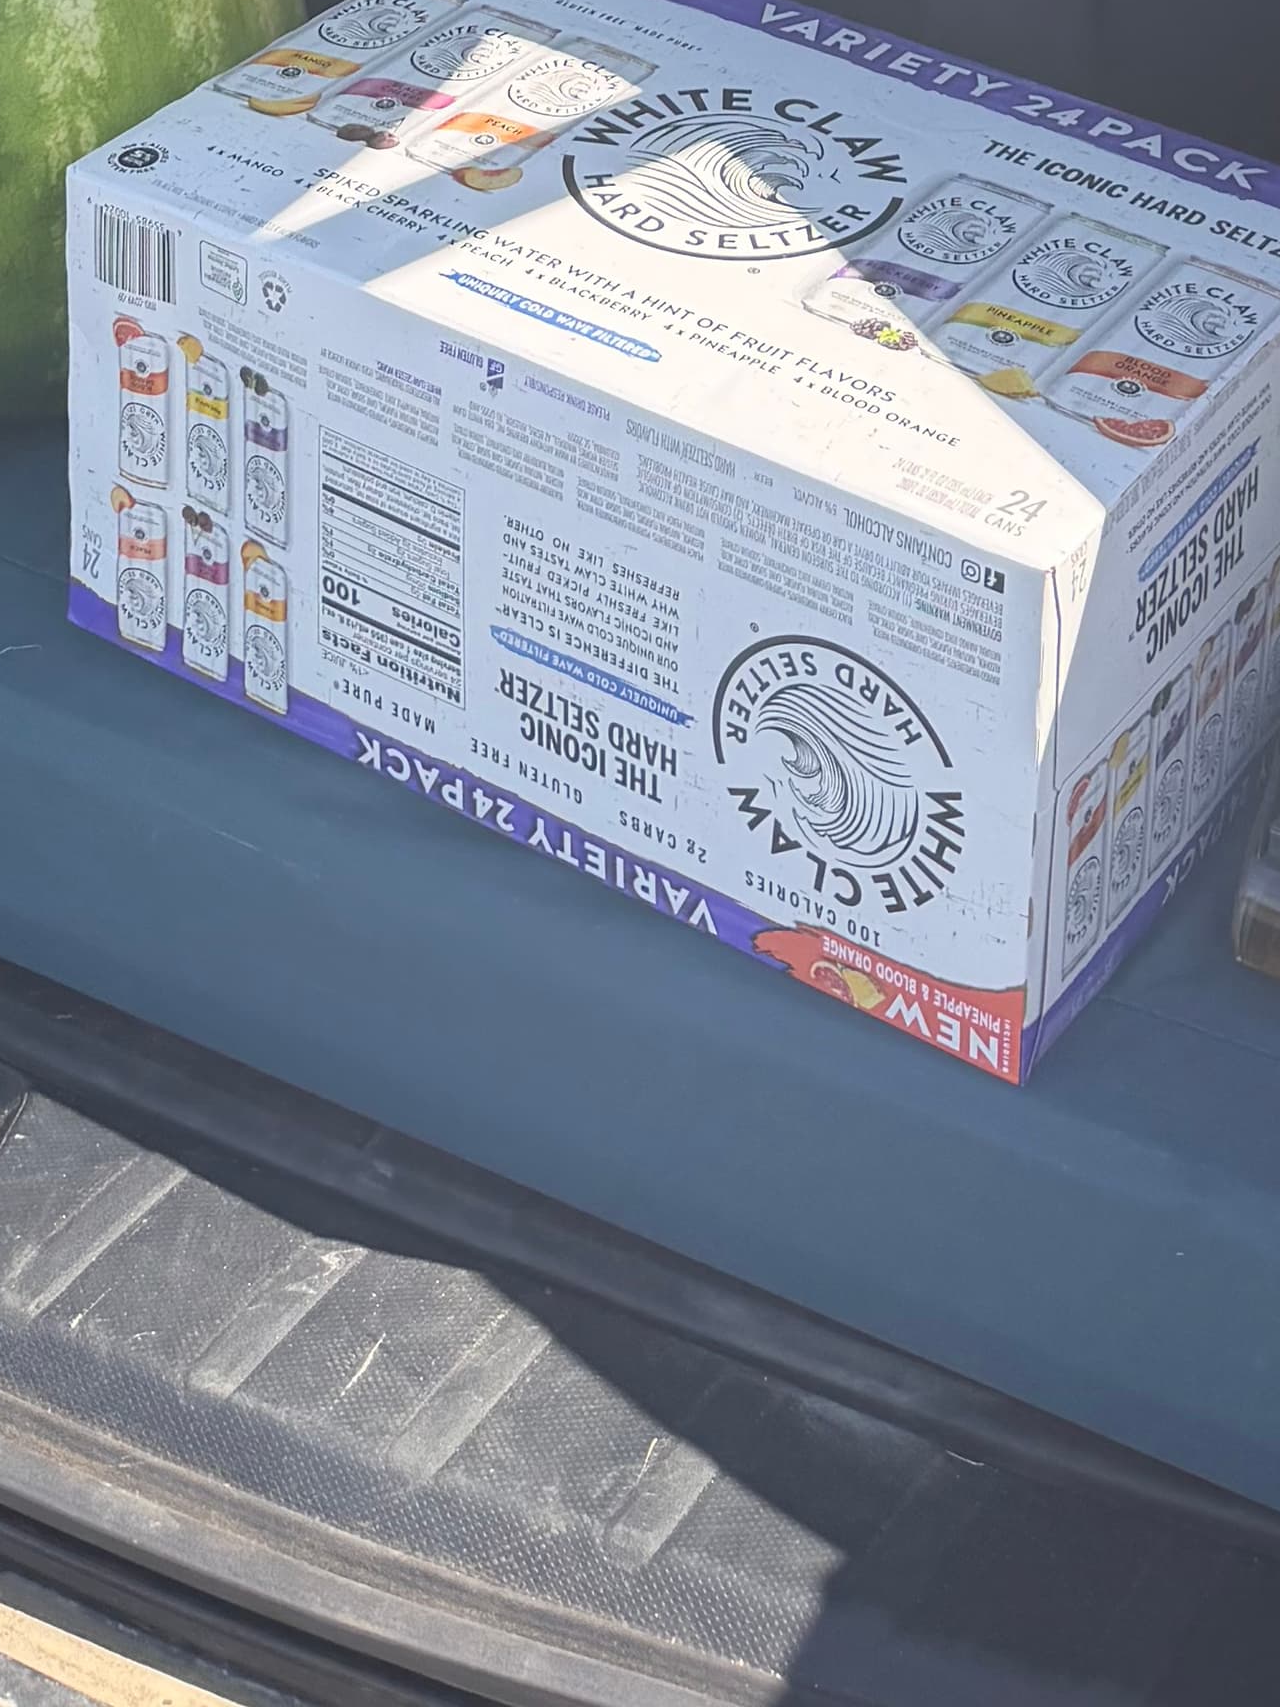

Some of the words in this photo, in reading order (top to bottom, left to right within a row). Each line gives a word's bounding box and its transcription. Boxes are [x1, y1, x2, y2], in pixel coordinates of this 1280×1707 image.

[761, 3, 1011, 97] VARIETY
[1015, 94, 1080, 128] 24
[1088, 117, 1269, 190] PACK
[573, 87, 753, 146] WHITE
[774, 97, 907, 184] CLAW
[227, 152, 285, 178] MANGO
[982, 139, 1034, 167] THE
[1034, 157, 1129, 199] ICONIC
[1129, 192, 1207, 228] HARD
[583, 172, 666, 234] HARD
[684, 203, 871, 251] SELTZER
[314, 166, 381, 198] SPIKED
[382, 193, 489, 241] SPARKLING
[494, 235, 564, 269] WATER
[567, 263, 626, 295] WITH
[621, 288, 638, 300] A
[642, 294, 695, 322] HINT
[696, 314, 726, 332] OF
[727, 329, 793, 361] FRUIT
[796, 356, 897, 403] FLAVORS
[549, 275, 653, 322] BLACKBERRY
[986, 305, 1054, 338] PINEAPPLE
[687, 331, 782, 376] PINEAPPLE
[819, 385, 881, 414] BLOOD
[885, 411, 961, 448] ORANGE
[997, 489, 1048, 524] 24
[501, 514, 545, 541] OTHER.
[501, 566, 533, 591] TASTE
[529, 546, 570, 572] TASTES
[321, 576, 361, 606] 100
[547, 568, 590, 598] PICKED
[611, 560, 680, 600] REFRESHES
[501, 585, 557, 620] FILTRATION
[558, 608, 585, 631] WAVE
[564, 595, 611, 627] FLAVORS
[595, 590, 647, 623] FRESHLY
[321, 630, 371, 664] Facts
[391, 606, 461, 648] Calories
[587, 622, 615, 647] COLD
[564, 632, 649, 681] DIFFERENCE
[616, 634, 655, 661] UNIQUE
[657, 652, 679, 672] OUR
[376, 653, 462, 704] Nutrition
[652, 673, 679, 694] THE
[725, 649, 818, 744] SELTZER
[391, 701, 436, 734] MADE
[498, 668, 600, 739] SELTZER
[620, 685, 678, 722] UNIQUELY
[833, 661, 924, 746] HARD
[469, 736, 510, 769] FREE
[518, 712, 607, 777] ICONIC
[607, 721, 678, 776] HARD
[355, 731, 464, 810] PACK
[517, 761, 583, 804] GLUTEN
[613, 756, 662, 803] THE
[471, 788, 516, 833] 24
[618, 809, 677, 849] CARBS
[686, 837, 707, 864] 2g
[726, 785, 863, 908] CLAW
[870, 789, 966, 914] WHITE
[527, 816, 718, 936] VARIETY
[744, 869, 836, 927] CALORIES
[846, 917, 881, 948] 100
[822, 936, 872, 971] ORANGE
[876, 961, 917, 995] BLOOD
[920, 984, 929, 1001] &
[932, 989, 1001, 1033] PINEAPPLE
[884, 994, 1001, 1070] NEW
